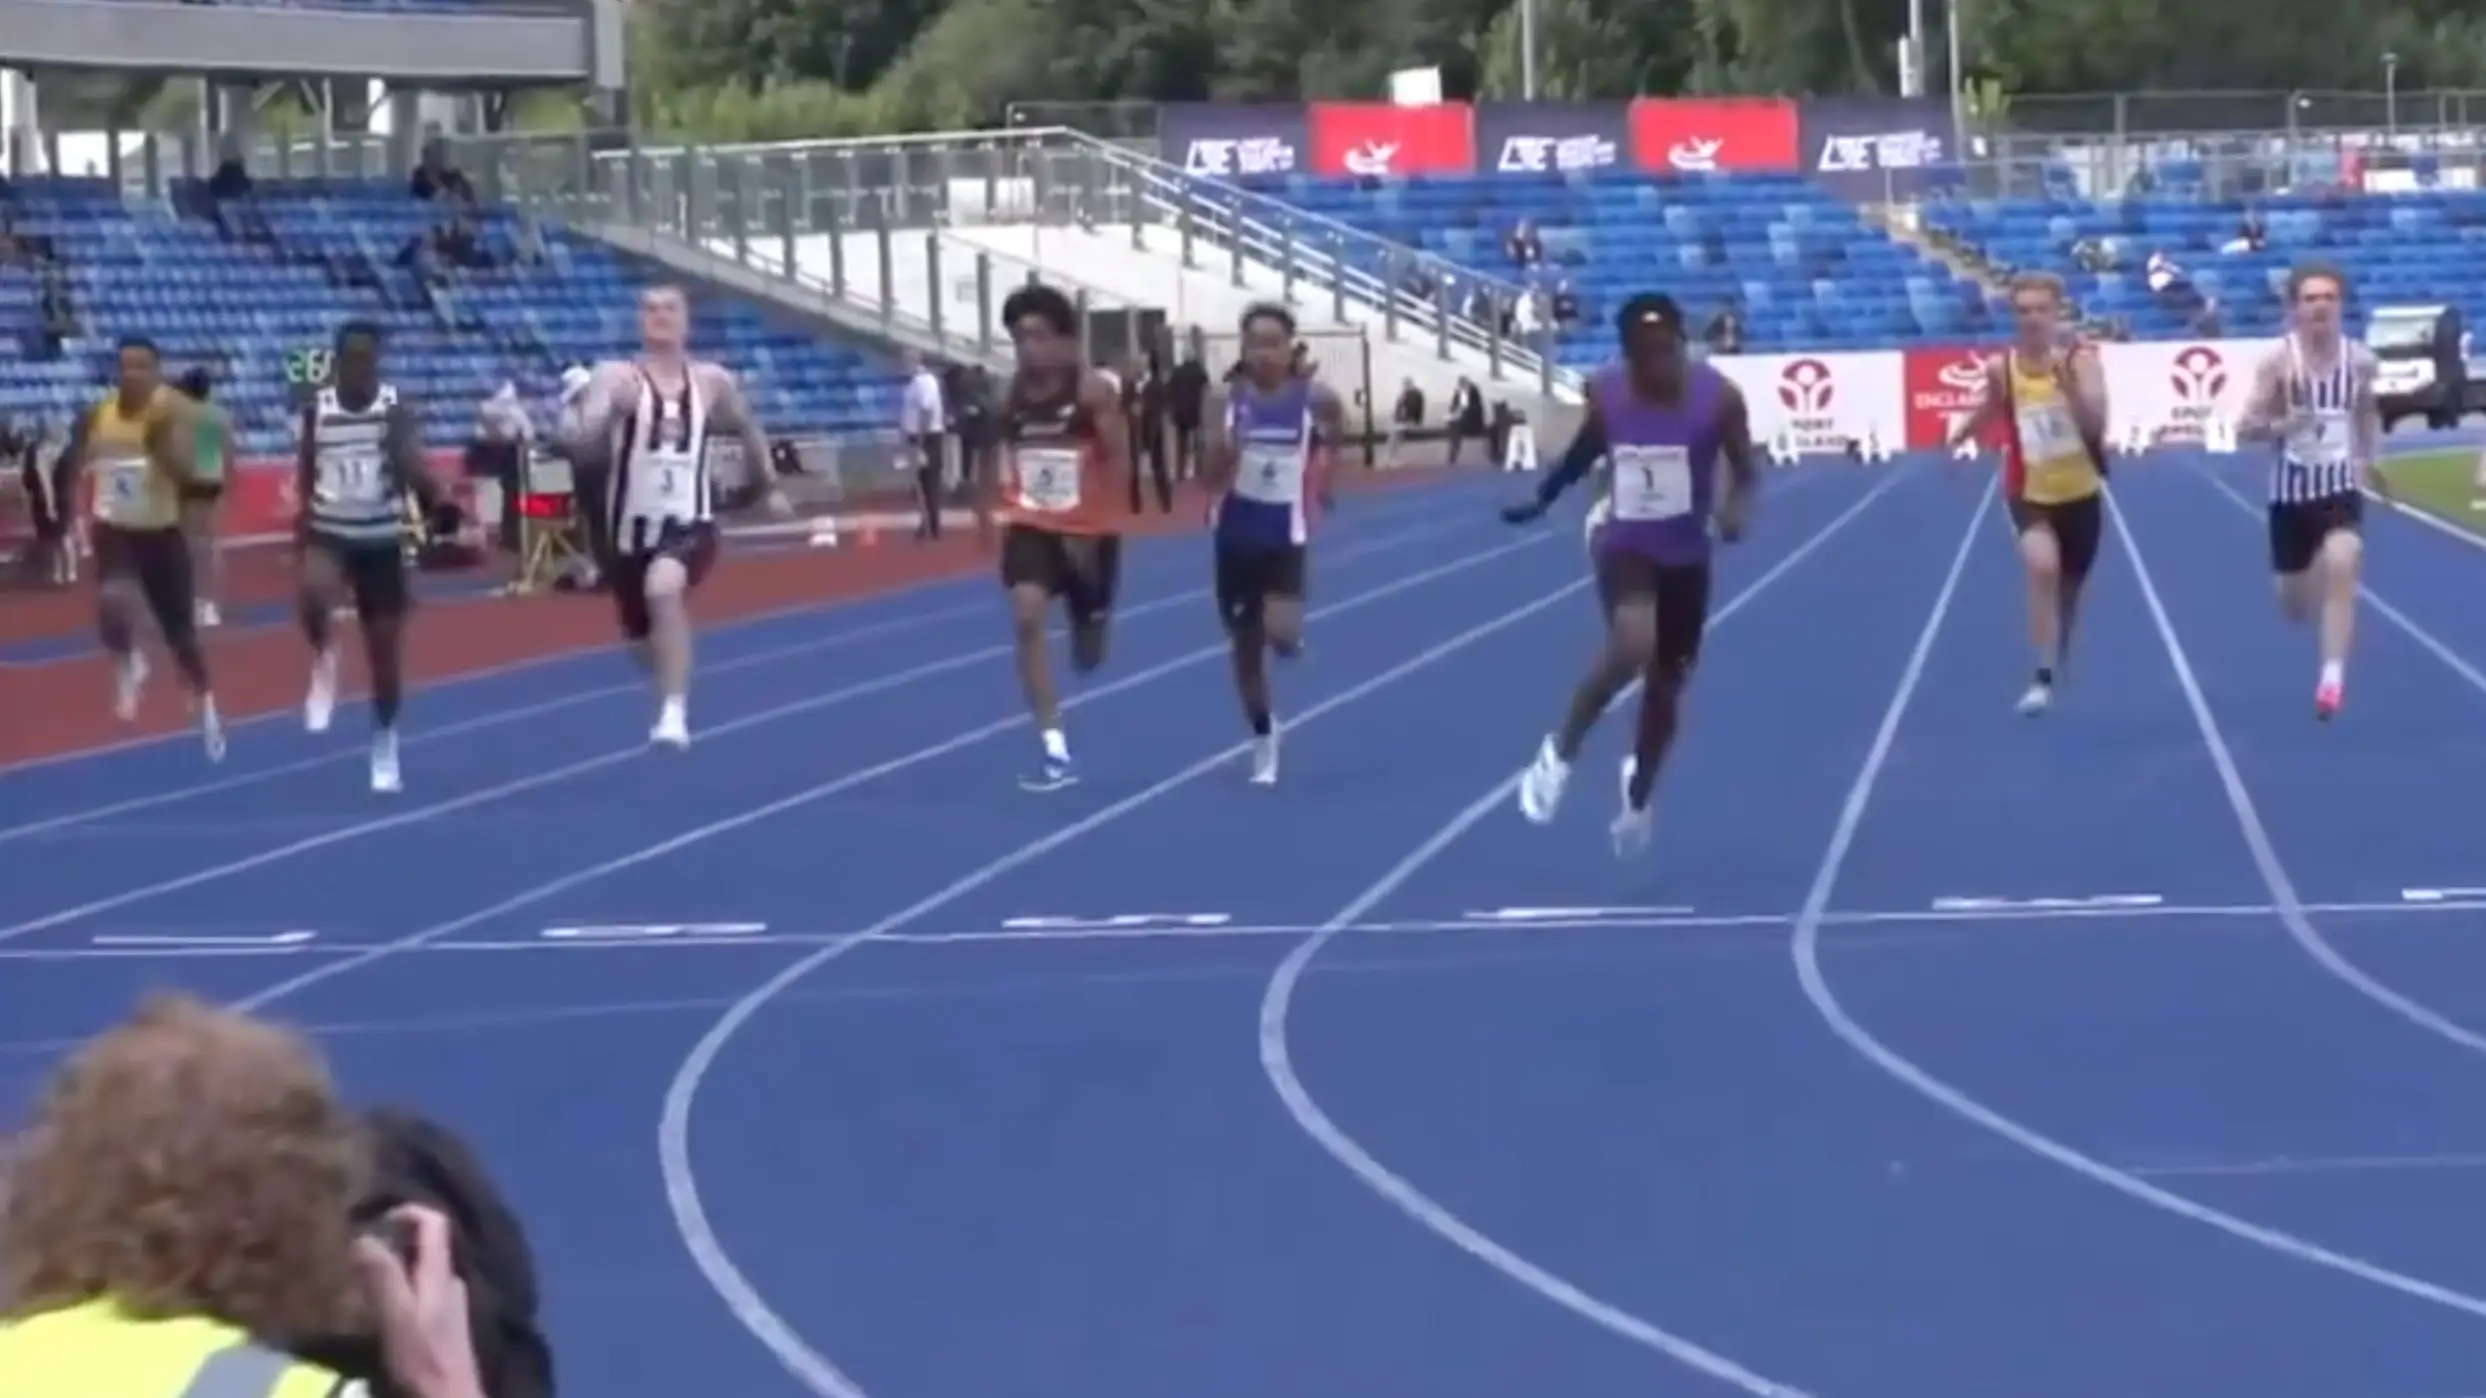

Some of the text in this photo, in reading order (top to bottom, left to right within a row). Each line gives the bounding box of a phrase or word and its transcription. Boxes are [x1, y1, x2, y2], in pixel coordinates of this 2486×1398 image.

[284, 348, 335, 383] 26
[1913, 391, 1986, 410] ENGLA
[1641, 466, 1655, 492] 1
